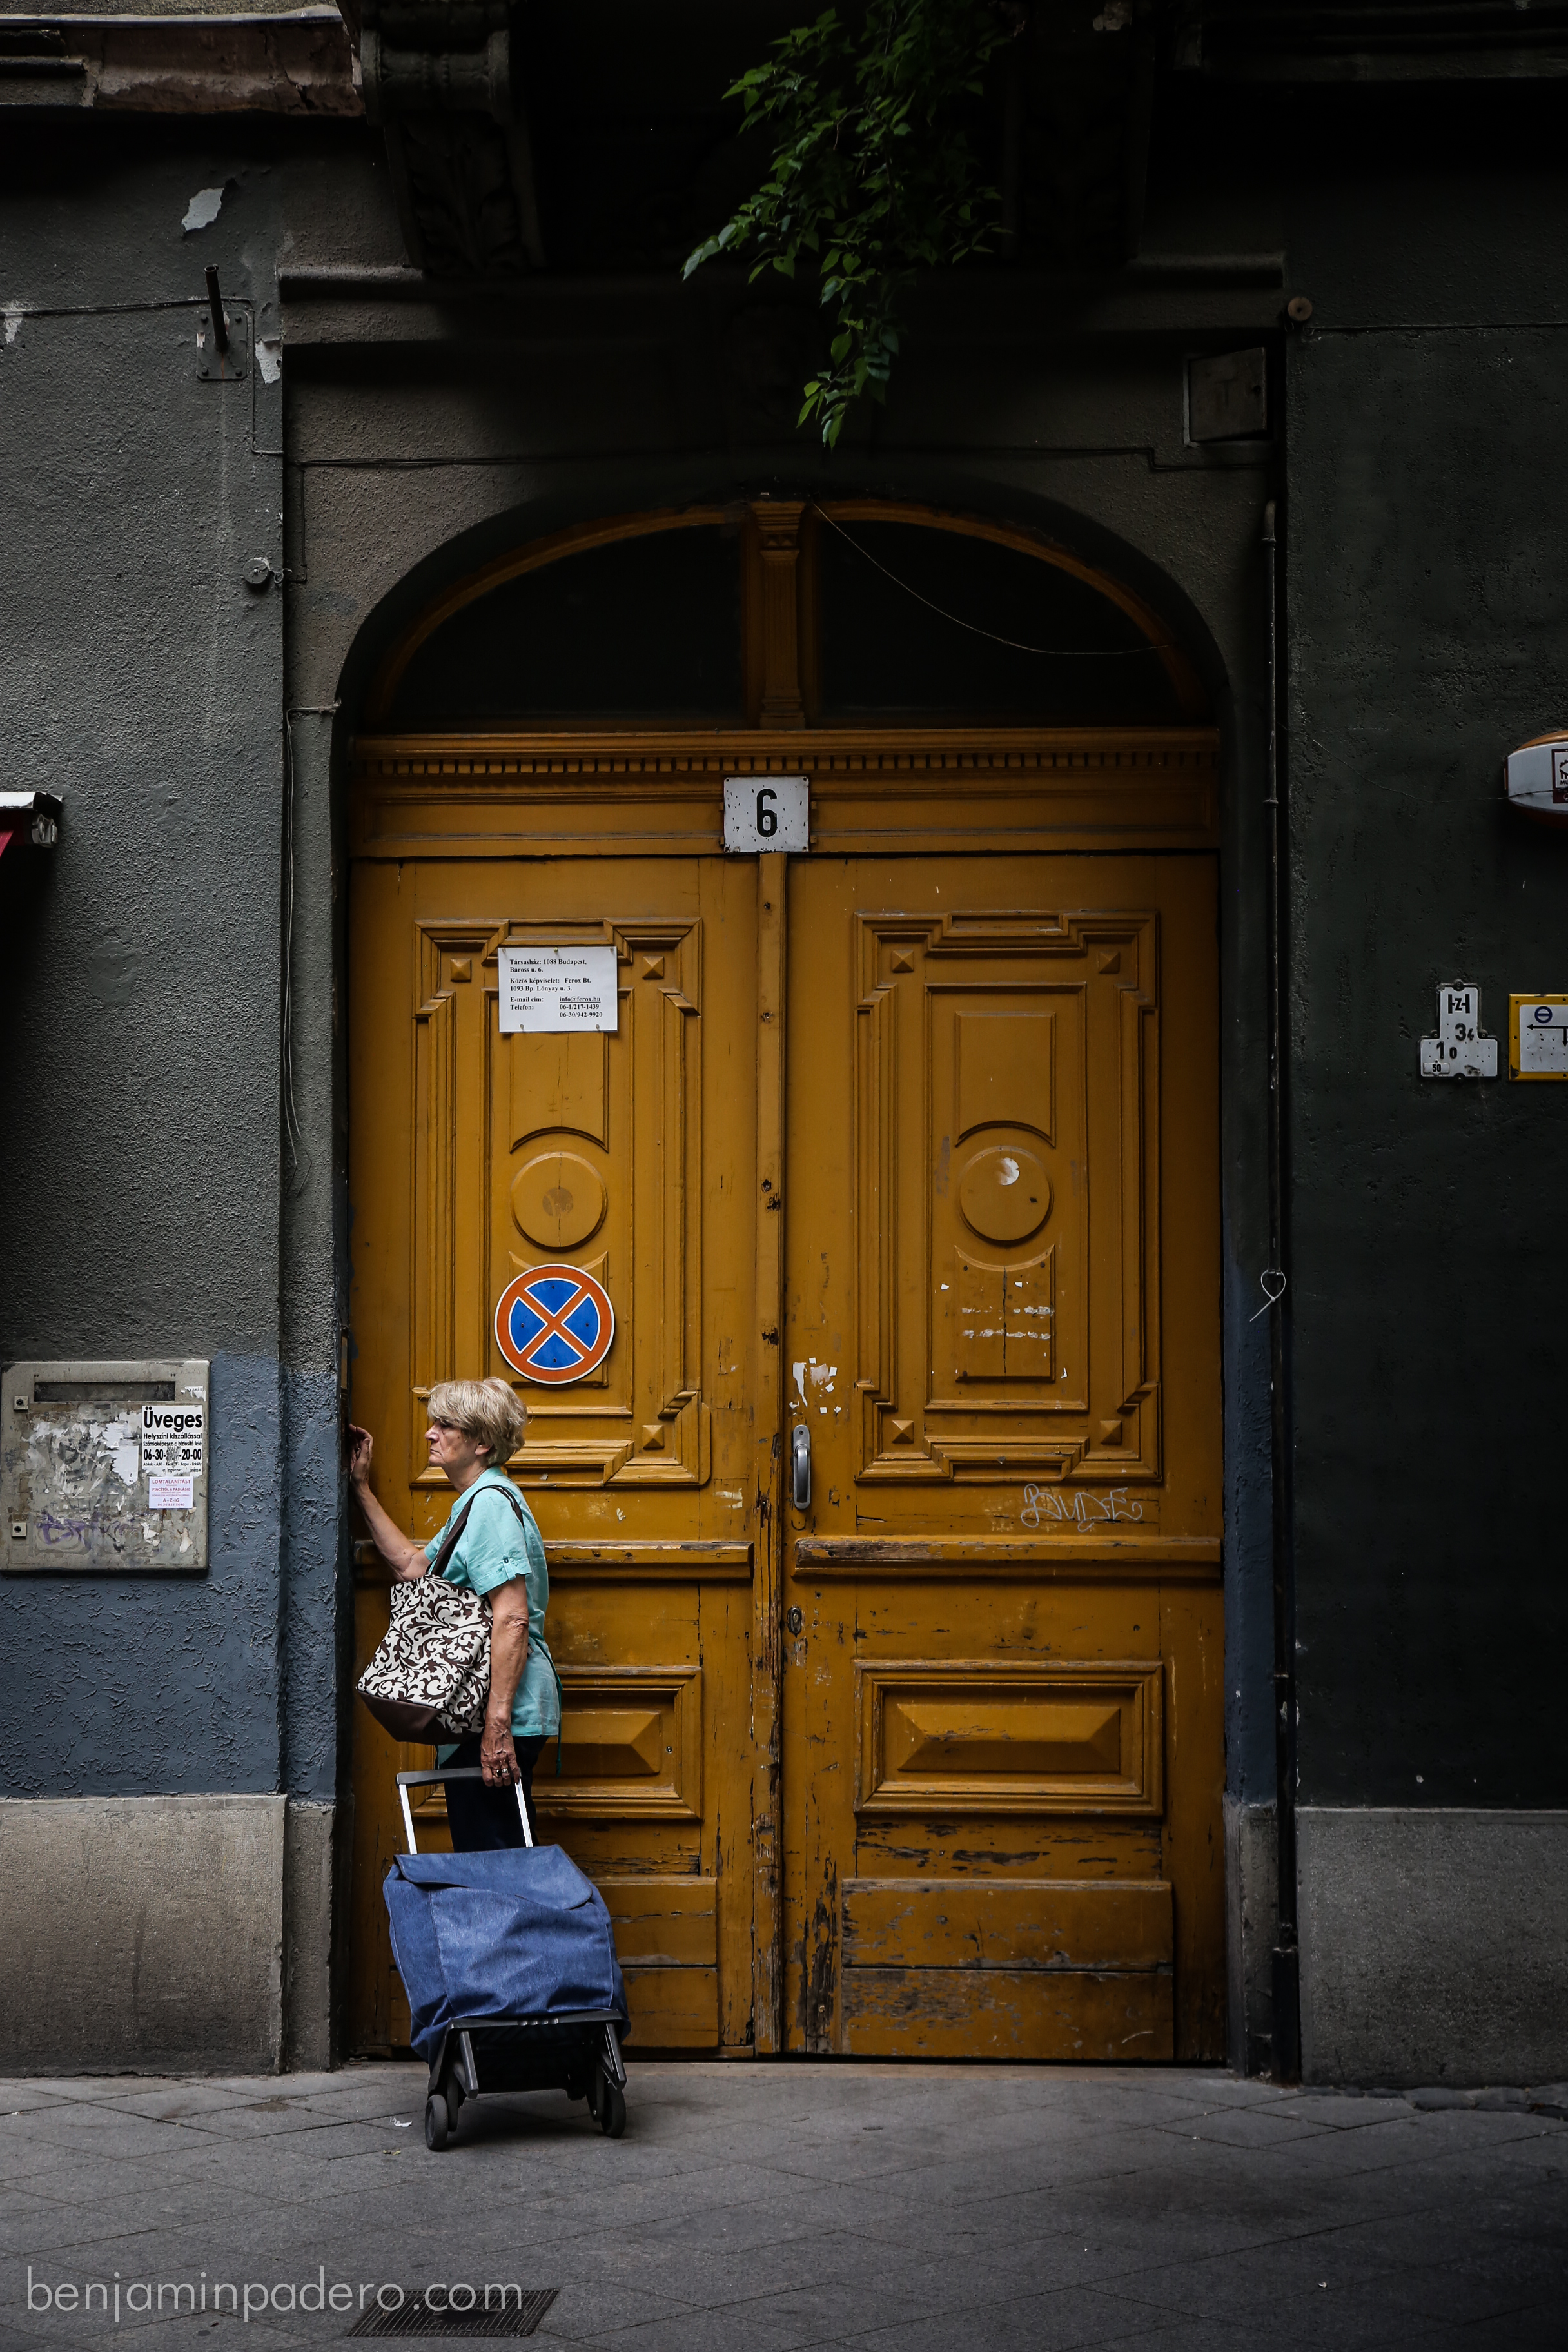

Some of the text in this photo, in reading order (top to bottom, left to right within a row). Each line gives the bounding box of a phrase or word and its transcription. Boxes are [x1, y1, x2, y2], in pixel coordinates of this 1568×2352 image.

[756, 789, 778, 838] 6
[1432, 1064, 1442, 1072] 50
[144, 1406, 202, 1432] Üveges
